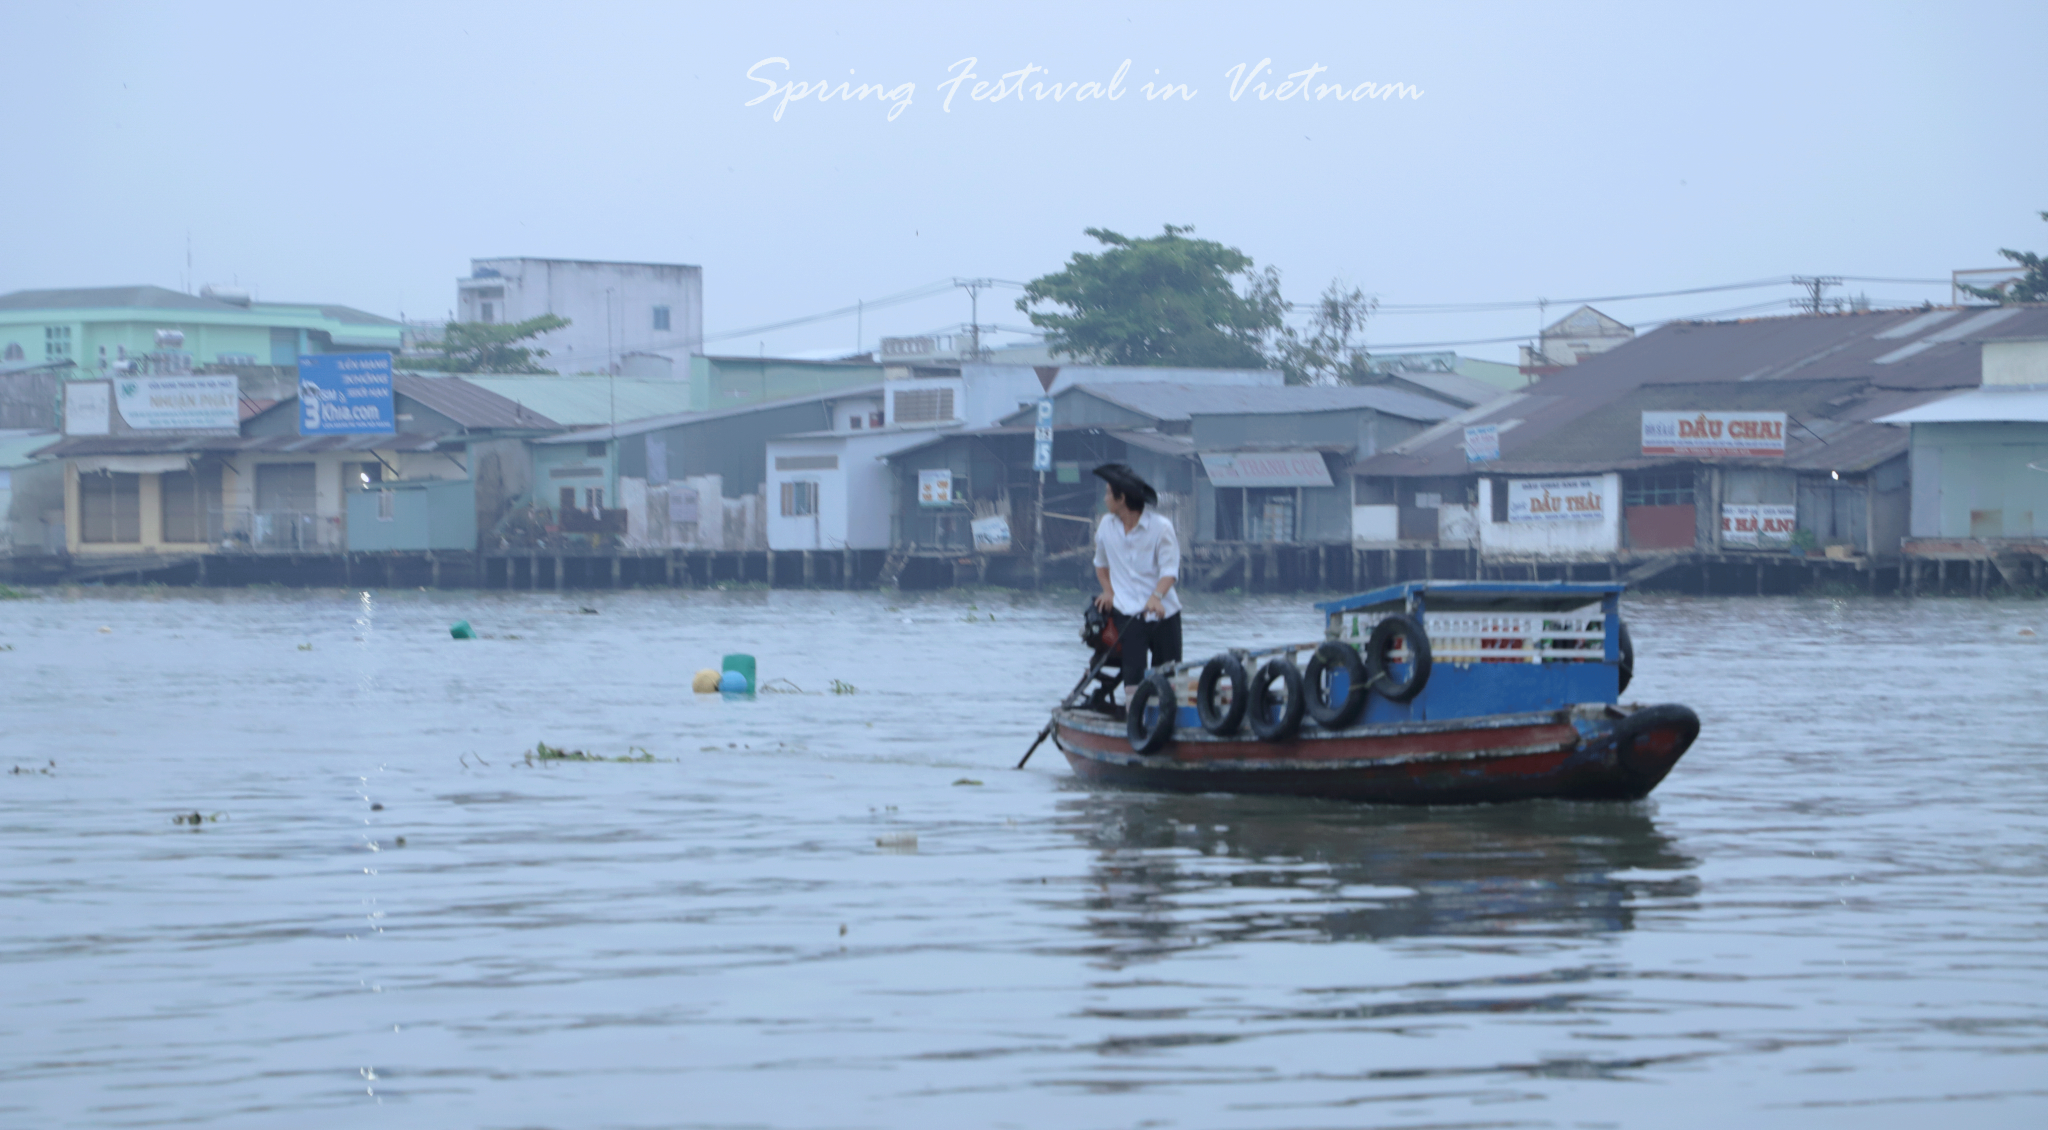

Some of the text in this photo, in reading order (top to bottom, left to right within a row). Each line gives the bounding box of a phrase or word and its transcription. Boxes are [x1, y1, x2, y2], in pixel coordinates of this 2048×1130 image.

[1678, 413, 1723, 439] DẦU
[1727, 420, 1783, 440] CHAI
[1529, 488, 1562, 513] DẦU
